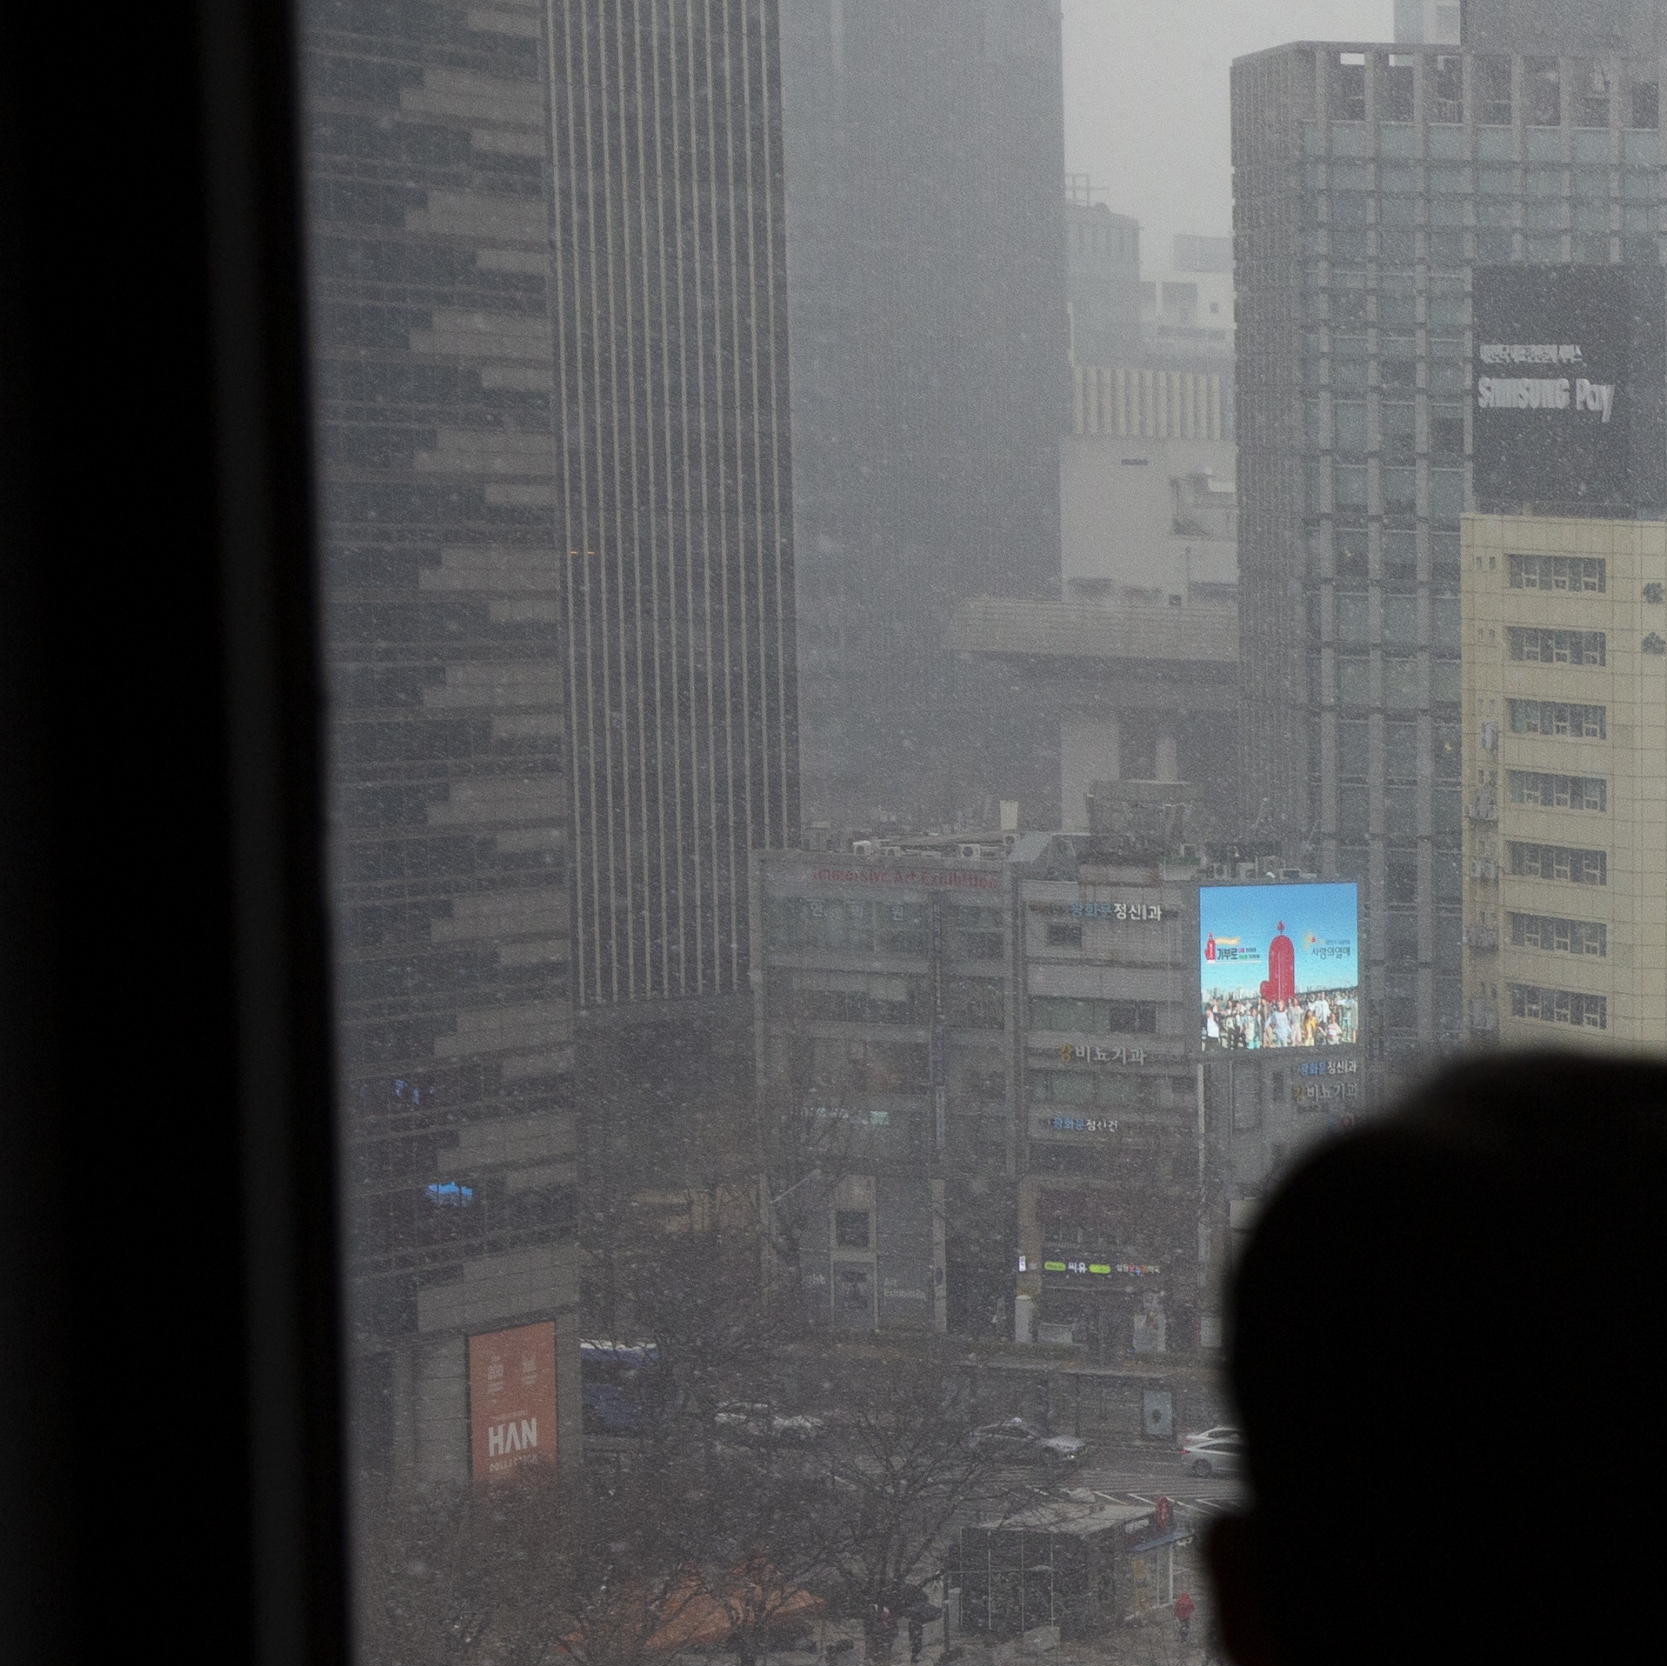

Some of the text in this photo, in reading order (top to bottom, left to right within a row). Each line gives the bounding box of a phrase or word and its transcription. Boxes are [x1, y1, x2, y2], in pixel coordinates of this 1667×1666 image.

[1576, 377, 1615, 423] Pay
[1217, 948, 1239, 961] 기부로
[1312, 947, 1351, 961] 사랑의열매
[488, 1417, 538, 1458] HAN
